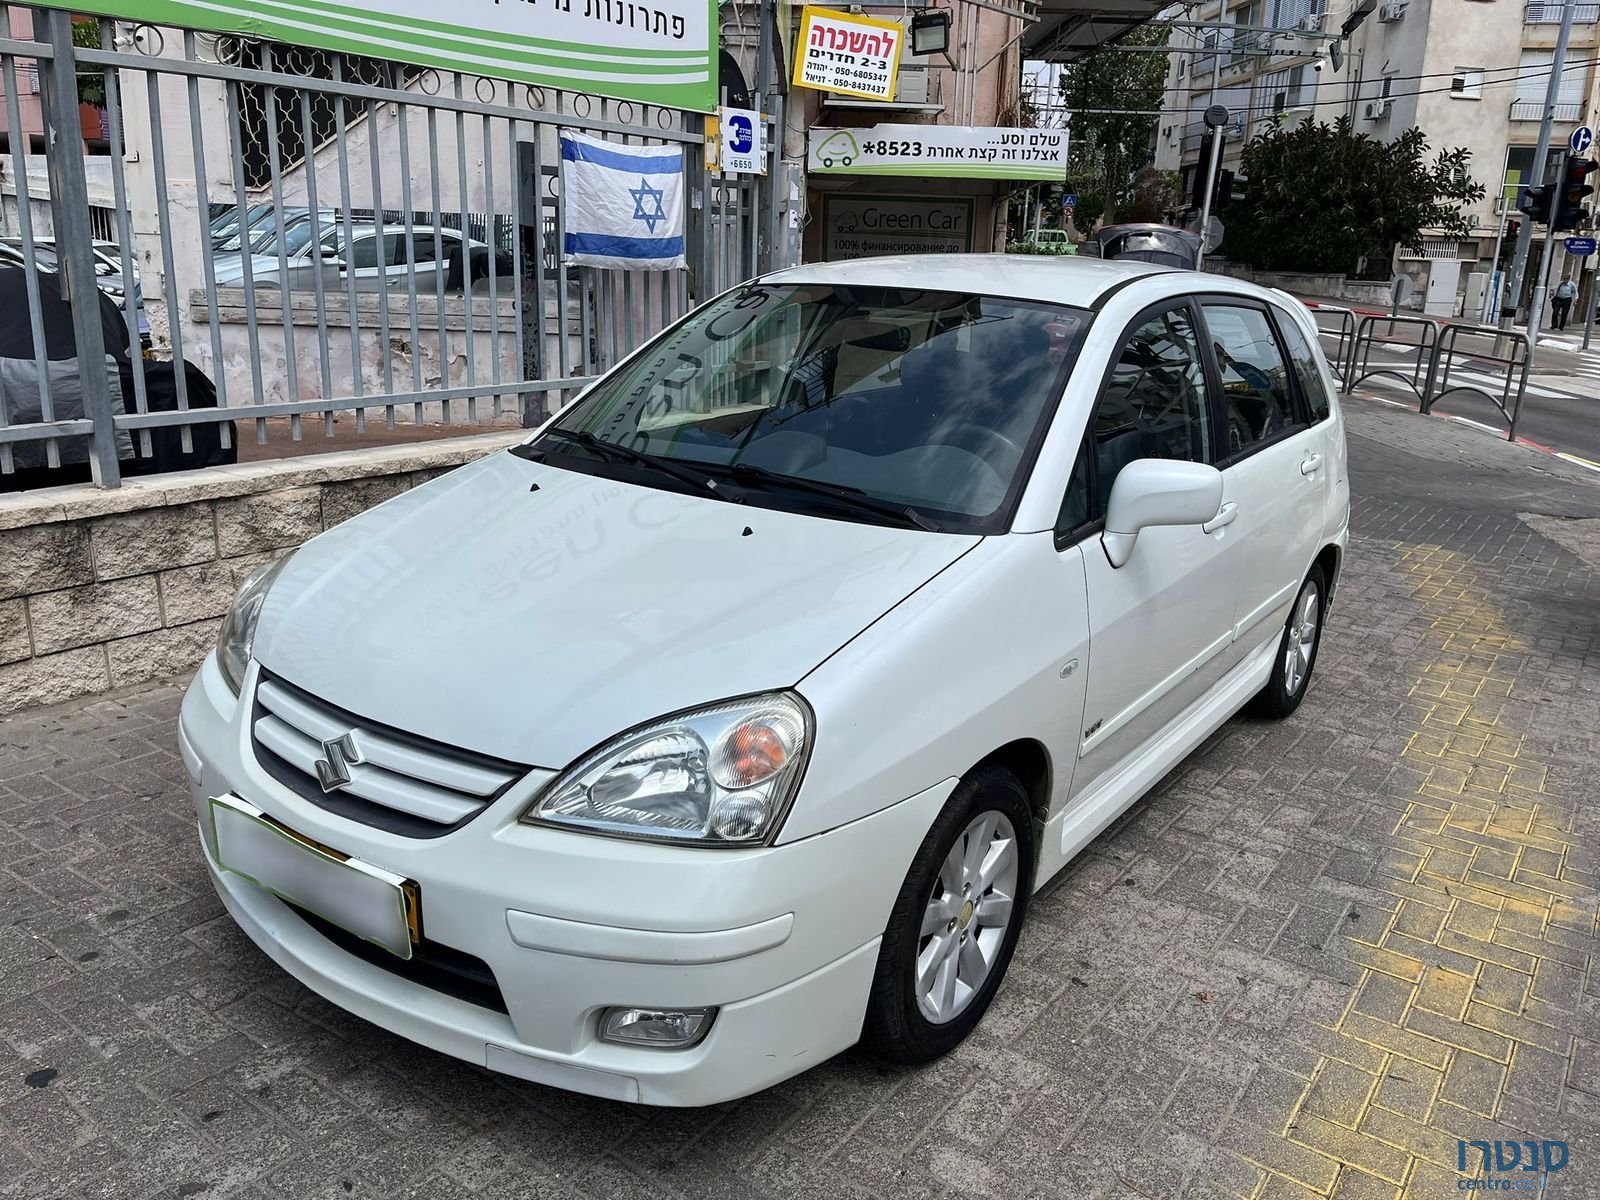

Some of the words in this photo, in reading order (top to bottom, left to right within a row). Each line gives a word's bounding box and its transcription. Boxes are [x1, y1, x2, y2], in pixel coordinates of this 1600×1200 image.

[584, 0, 685, 39] פתרונות
[810, 25, 894, 58] להשכרה
[809, 48, 855, 64] חדרים
[806, 61, 828, 72] יהודה
[835, 66, 888, 82] 050-6805347
[805, 71, 826, 83] דניאל
[833, 78, 886, 94] 050-8437437
[987, 134, 1025, 145] וסע...
[1029, 132, 1060, 146] שלם
[927, 146, 964, 158] אחרת
[968, 147, 997, 162] קצת
[1001, 148, 1017, 159] זה
[1021, 147, 1059, 161] אצלנו
[862, 207, 921, 229] Green
[927, 209, 962, 230] Car
[834, 240, 860, 250] 100%
[861, 240, 945, 254] финансирование
[945, 243, 960, 254] до
